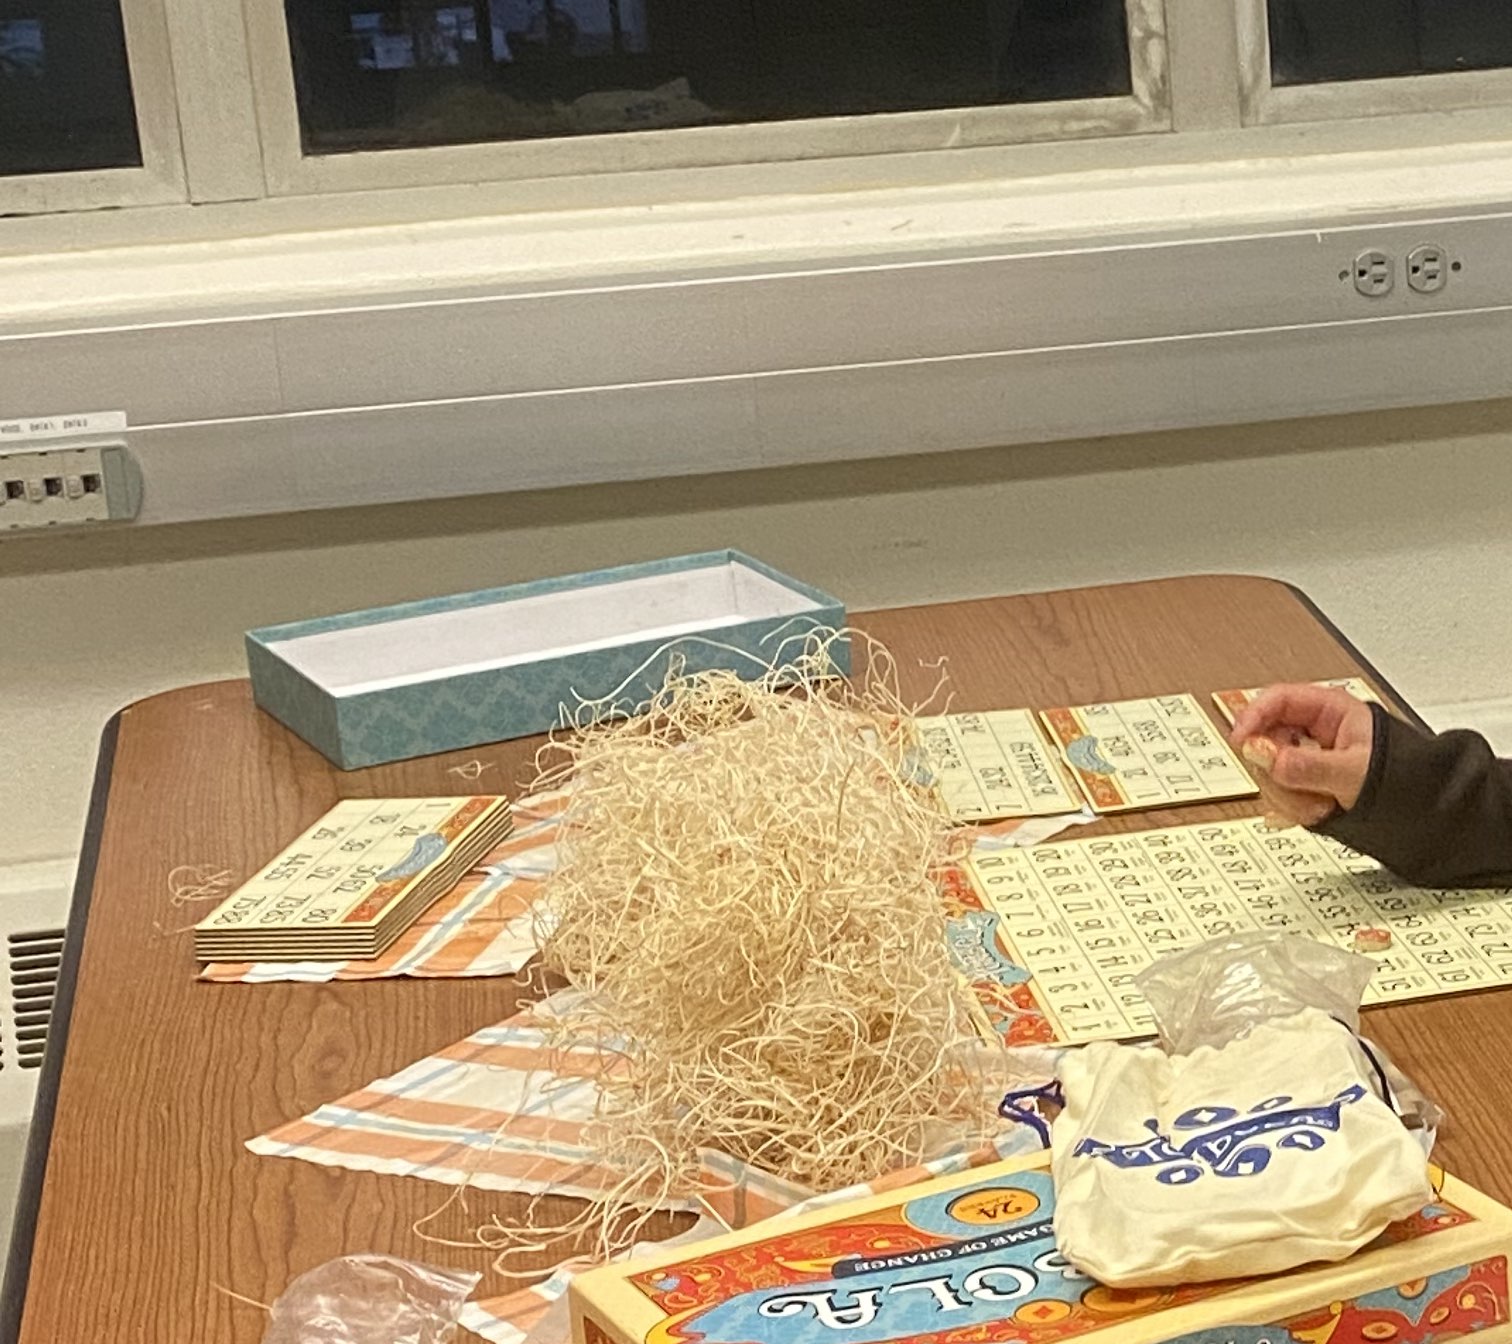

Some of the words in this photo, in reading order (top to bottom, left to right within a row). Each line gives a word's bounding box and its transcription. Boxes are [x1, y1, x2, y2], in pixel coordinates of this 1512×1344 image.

[1144, 834, 1172, 847] 40
[1198, 828, 1228, 841] 50
[1089, 841, 1119, 855] 30
[1210, 844, 1240, 856] 49
[1032, 848, 1061, 862] 20
[1155, 851, 1185, 865] 39
[977, 857, 1005, 869] 10
[1099, 858, 1129, 872] 29
[1222, 860, 1252, 873] 48
[1043, 866, 1072, 879] 19
[1166, 867, 1197, 882] 38
[987, 876, 1014, 885] 9
[1110, 875, 1141, 889] 28
[1234, 878, 1265, 891] 47
[1053, 883, 1083, 896] 18
[1178, 886, 1209, 899] 37
[996, 893, 1024, 902] 8
[1121, 893, 1152, 906] 27
[1248, 895, 1279, 909] 46
[1063, 902, 1093, 913] 17
[1191, 902, 1222, 918] 36
[1006, 912, 1034, 920] 7
[1132, 910, 1164, 925] 26
[1391, 914, 1423, 929] 64
[1074, 918, 1105, 932] 16
[1465, 923, 1498, 938] 73
[1017, 929, 1044, 937] 6
[1145, 928, 1177, 943] 25
[1406, 931, 1438, 947] 63
[1086, 938, 1116, 950] 15
[1027, 947, 1055, 957] 5
[1422, 950, 1454, 965] 62
[1097, 956, 1129, 969] 14
[1438, 969, 1470, 983] 61
[1049, 983, 1078, 993] 3
[1060, 1003, 1090, 1013] 2
[976, 1200, 1022, 1220] 24
[960, 1241, 989, 1255] OF
[854, 1246, 953, 1273] CHANCE
